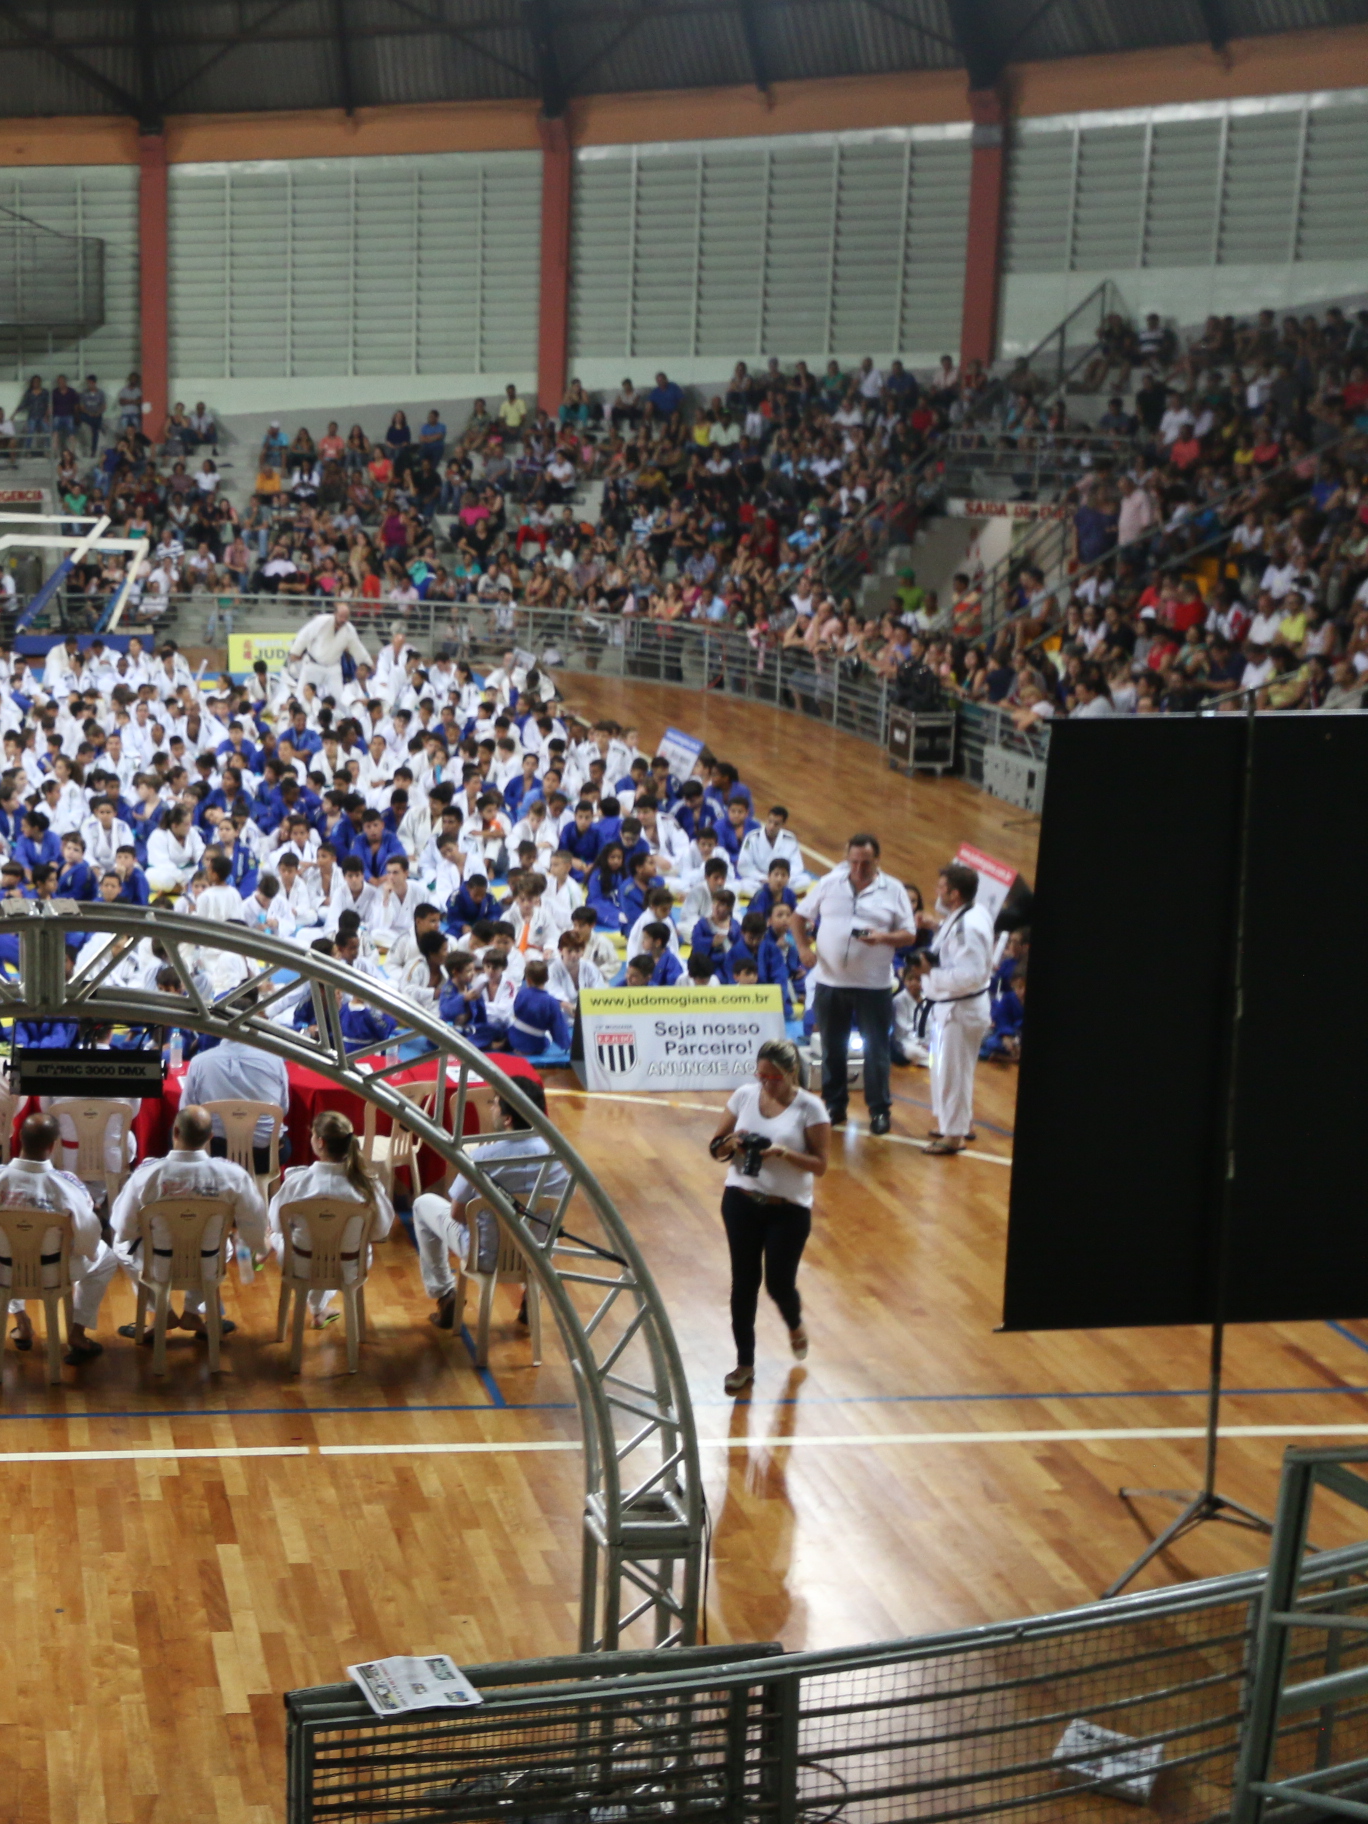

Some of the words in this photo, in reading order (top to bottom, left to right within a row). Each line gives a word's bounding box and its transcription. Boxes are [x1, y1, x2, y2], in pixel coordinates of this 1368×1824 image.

[590, 993, 769, 1008] www.judomogiana.com.br
[655, 1021, 696, 1039] Seja
[703, 1022, 760, 1036] nosso
[665, 1041, 753, 1056] Parceiro!
[85, 1066, 115, 1075] 3000
[118, 1067, 146, 1076] DMX
[647, 1060, 730, 1076] ANUNCIE
